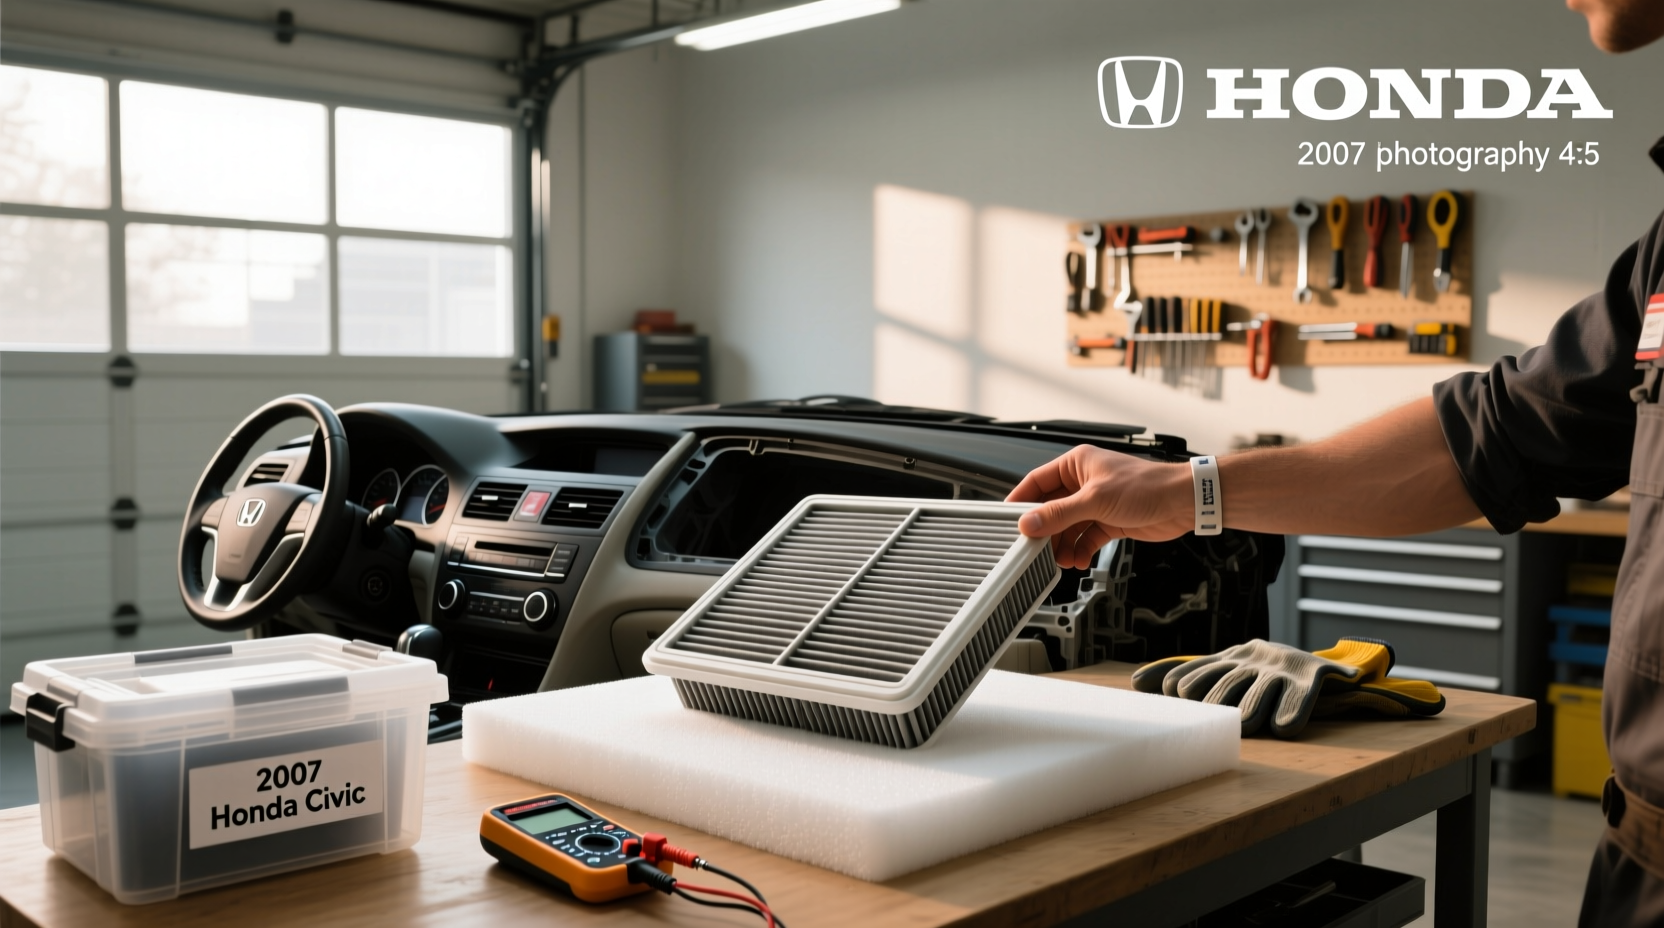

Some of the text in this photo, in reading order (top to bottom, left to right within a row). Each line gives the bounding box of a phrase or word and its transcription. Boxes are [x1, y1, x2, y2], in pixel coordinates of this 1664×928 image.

[256, 759, 323, 793] 2007
[210, 781, 366, 831] Honda Civic
